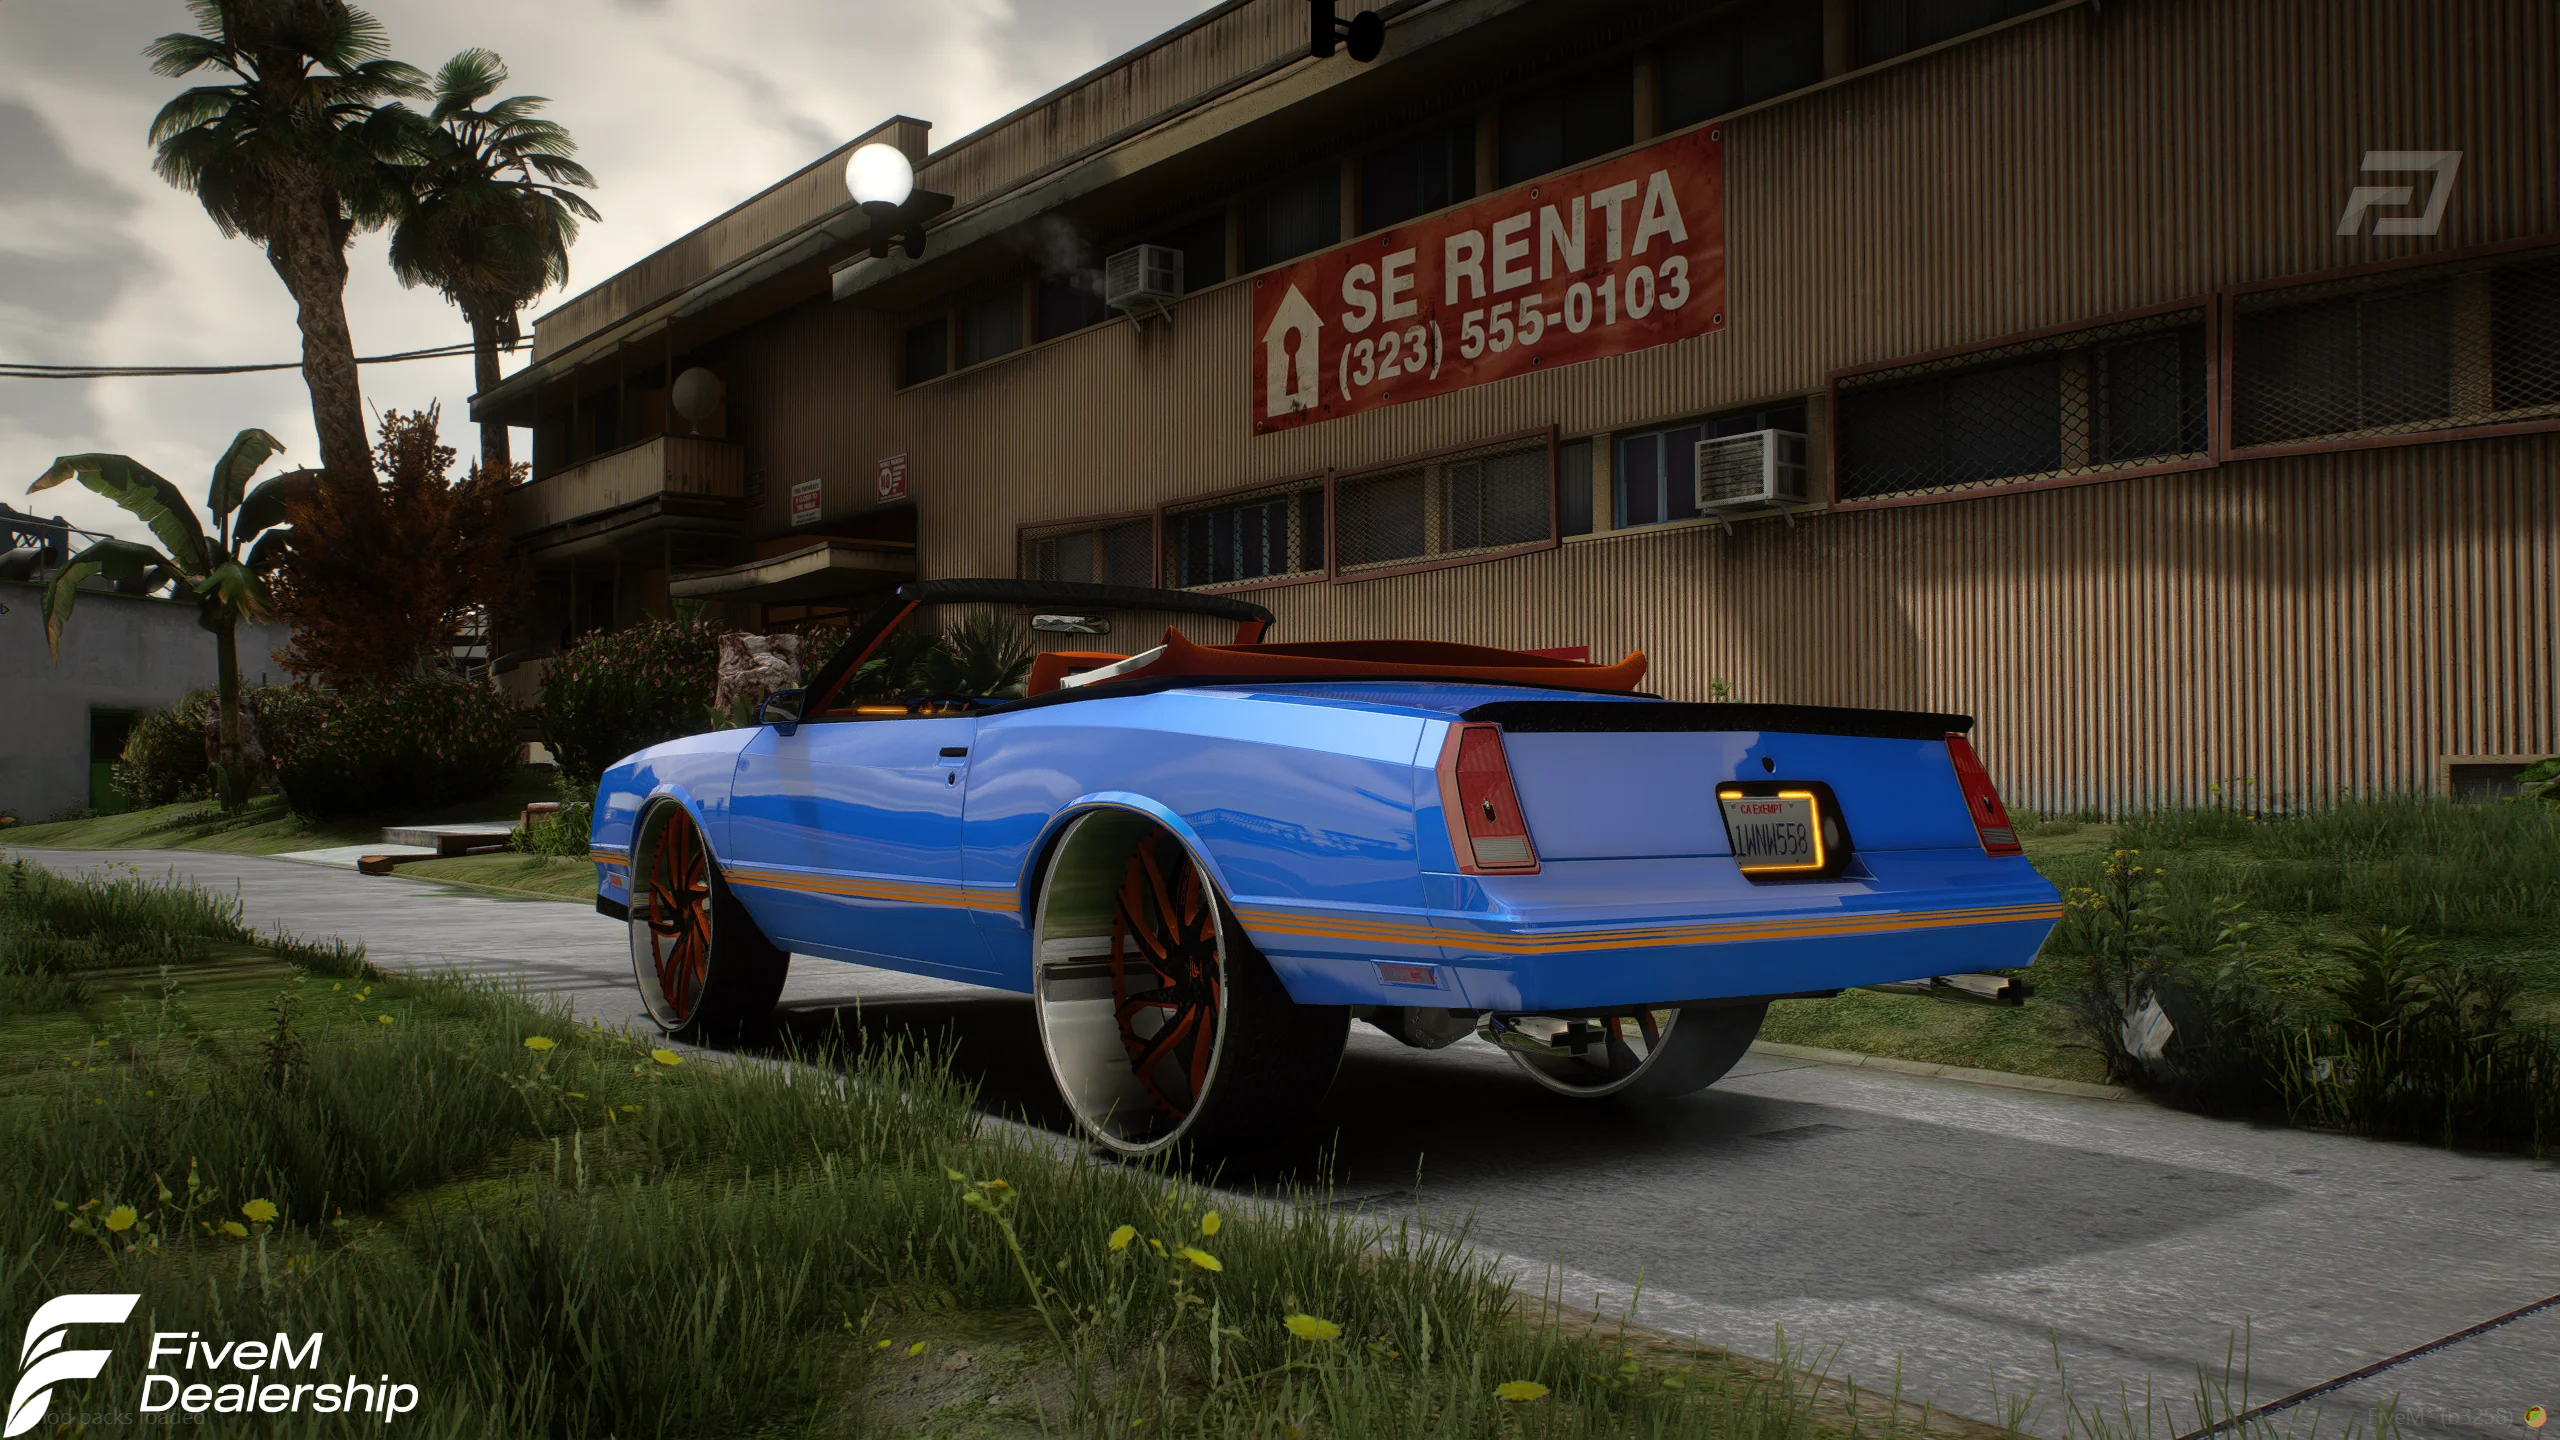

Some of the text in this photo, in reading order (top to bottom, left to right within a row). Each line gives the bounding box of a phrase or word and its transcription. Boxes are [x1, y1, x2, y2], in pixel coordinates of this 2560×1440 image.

[1341, 168, 1689, 334] SE RENTA
[1338, 255, 1691, 402] (323) 555-0103
[1735, 822, 1808, 857] 1WNW558
[1740, 803, 1784, 815] CA EXEMPT
